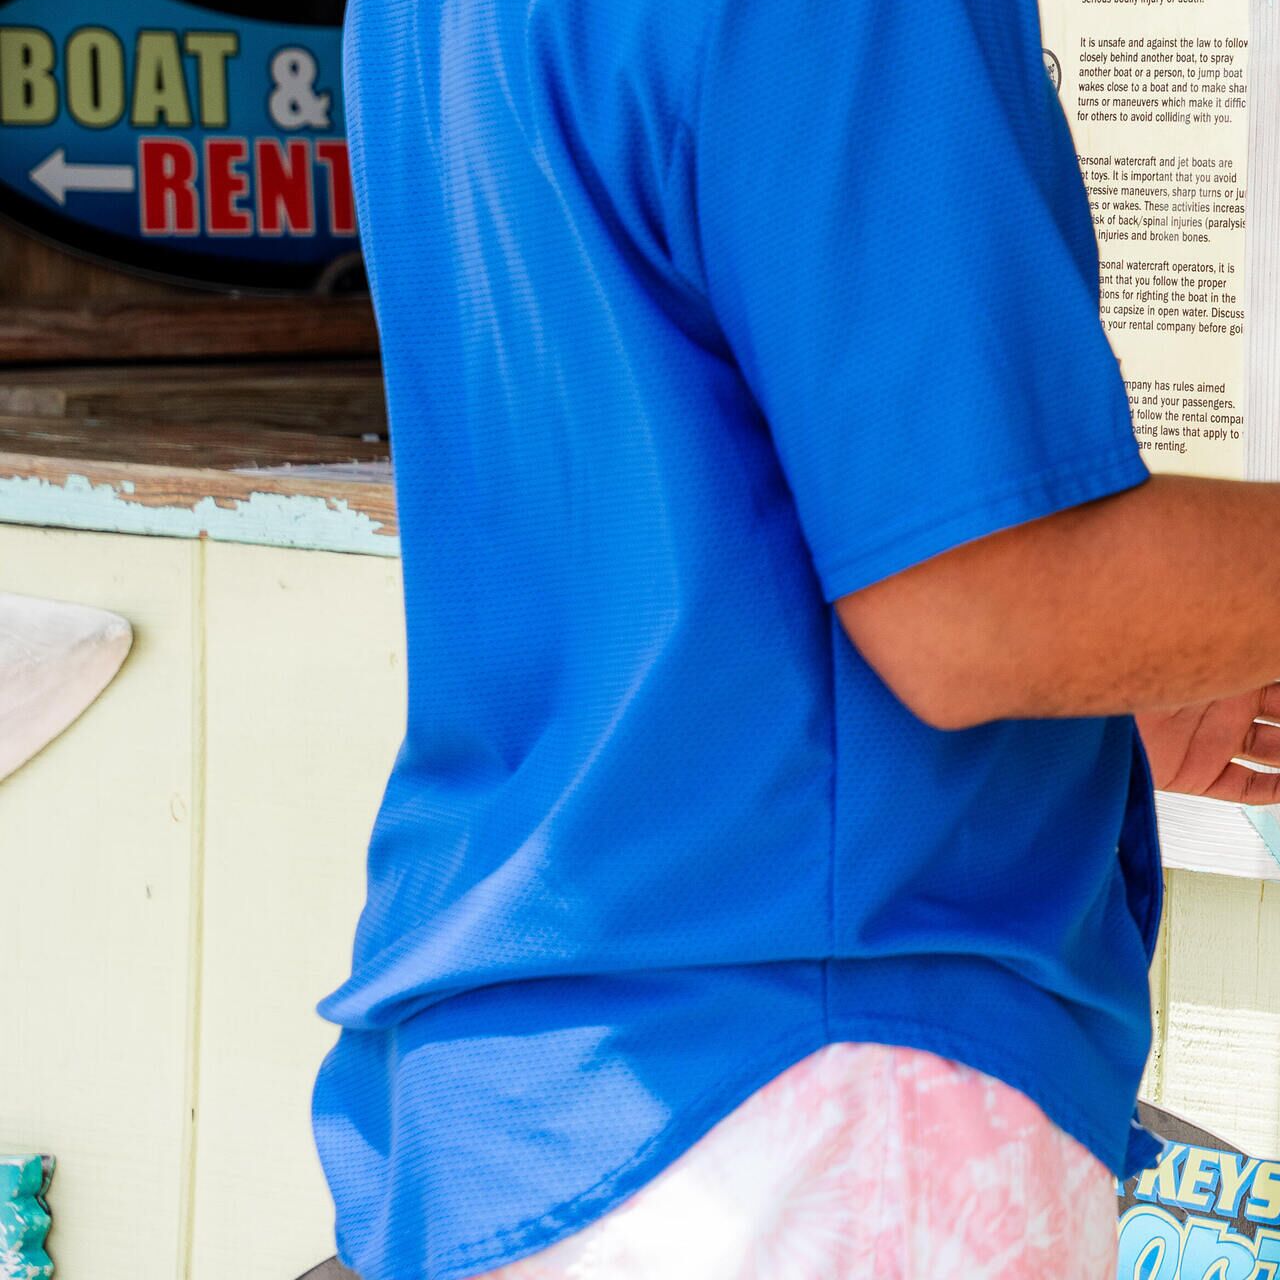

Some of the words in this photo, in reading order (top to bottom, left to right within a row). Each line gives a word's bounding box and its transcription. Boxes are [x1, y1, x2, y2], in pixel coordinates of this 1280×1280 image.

[0, 26, 239, 130] BOAT
[267, 46, 331, 131] &
[138, 136, 358, 237] RENT
